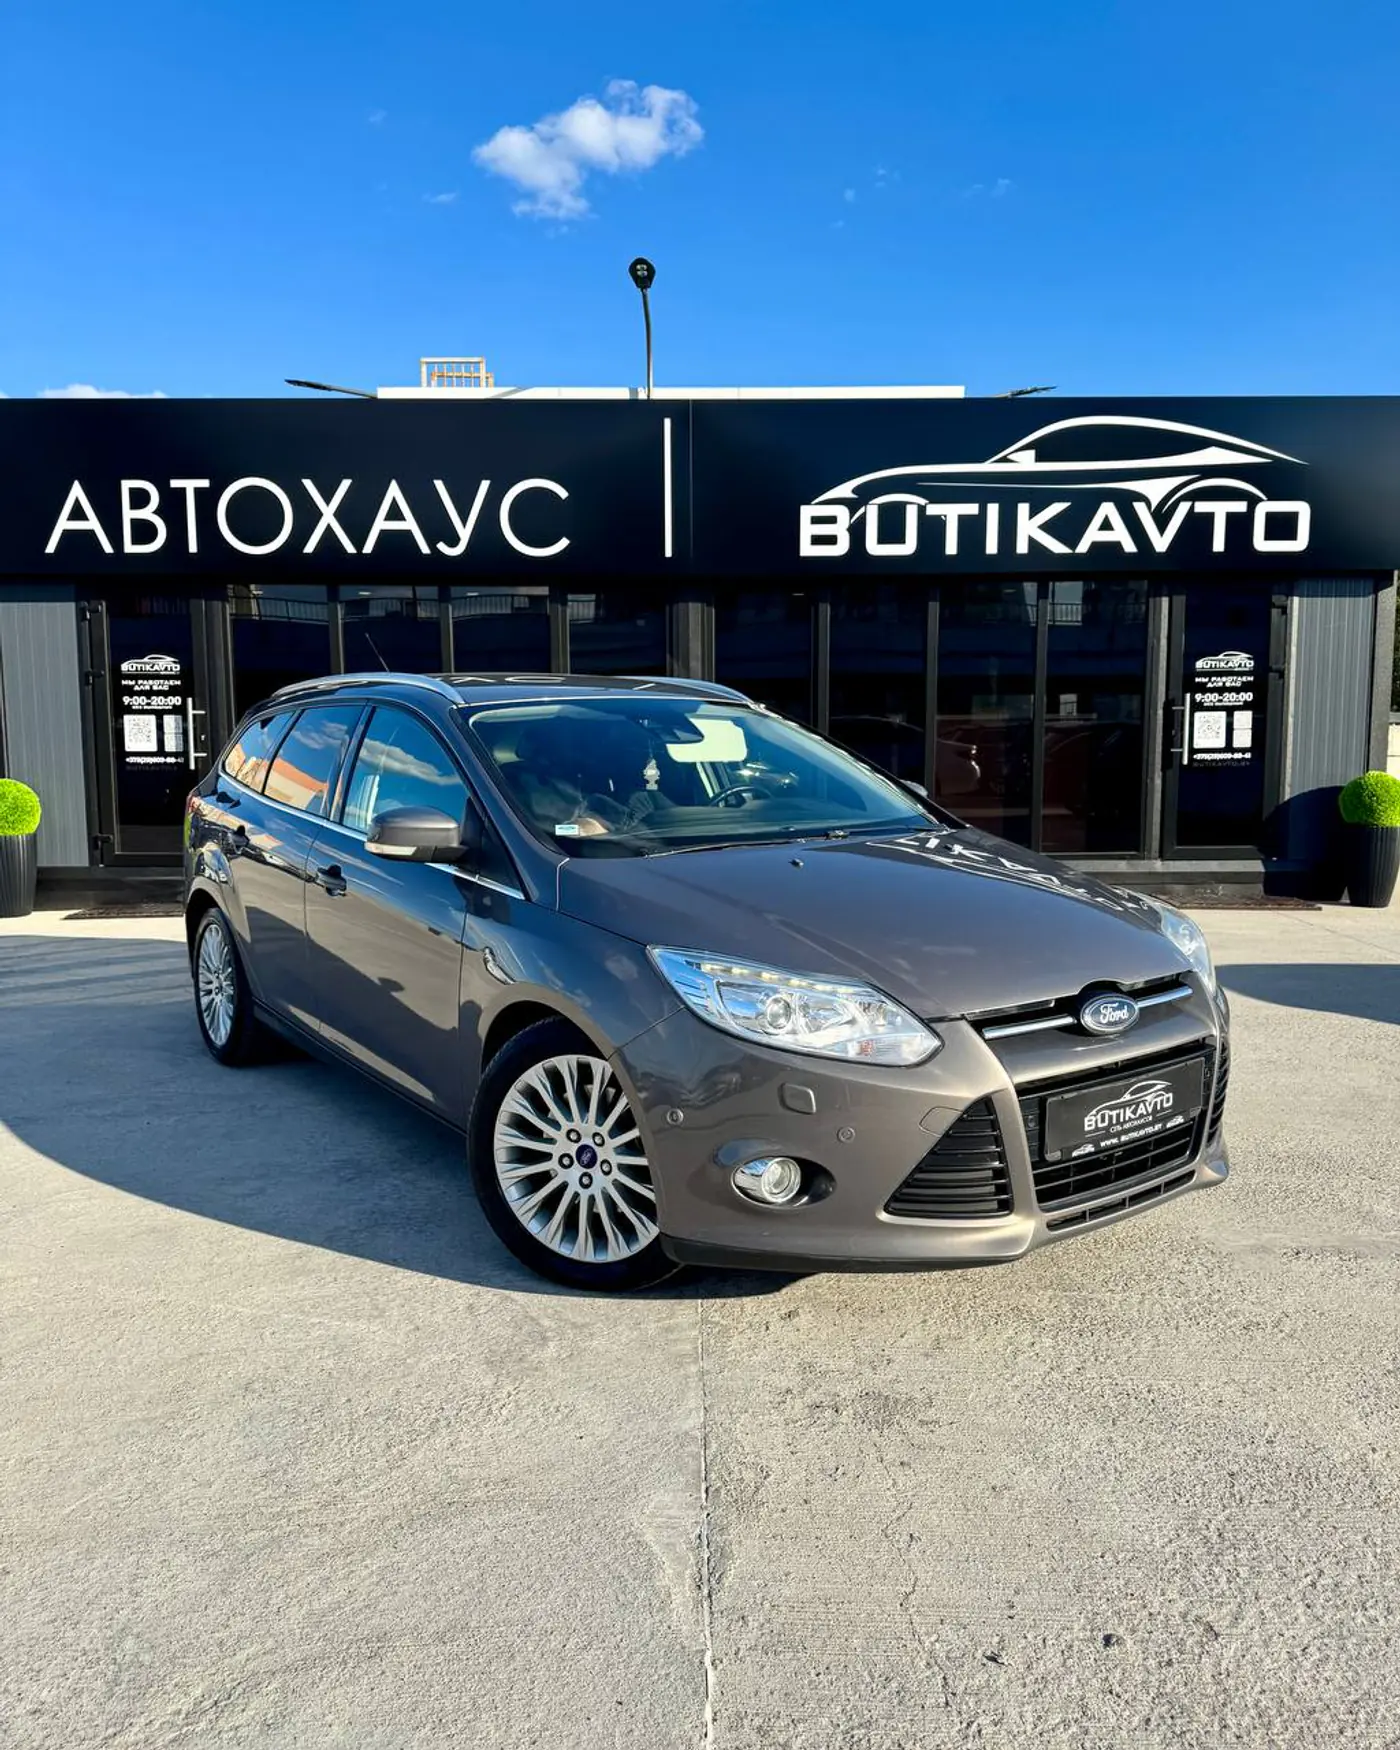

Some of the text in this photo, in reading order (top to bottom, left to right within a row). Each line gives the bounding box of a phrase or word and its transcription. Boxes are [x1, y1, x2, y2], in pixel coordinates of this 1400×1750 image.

[45, 476, 570, 557] АВТОХАУС
[799, 500, 1311, 557] BUTIKAVTO
[120, 663, 181, 672] BUTIKAVTO
[1195, 660, 1255, 669] BUTIKAVTO
[122, 696, 182, 705] 9:00-20:00
[1195, 692, 1254, 703] 9:00-20:00
[1099, 1002, 1129, 1024] Ford
[1084, 1092, 1173, 1132] BUTIKAVTO
